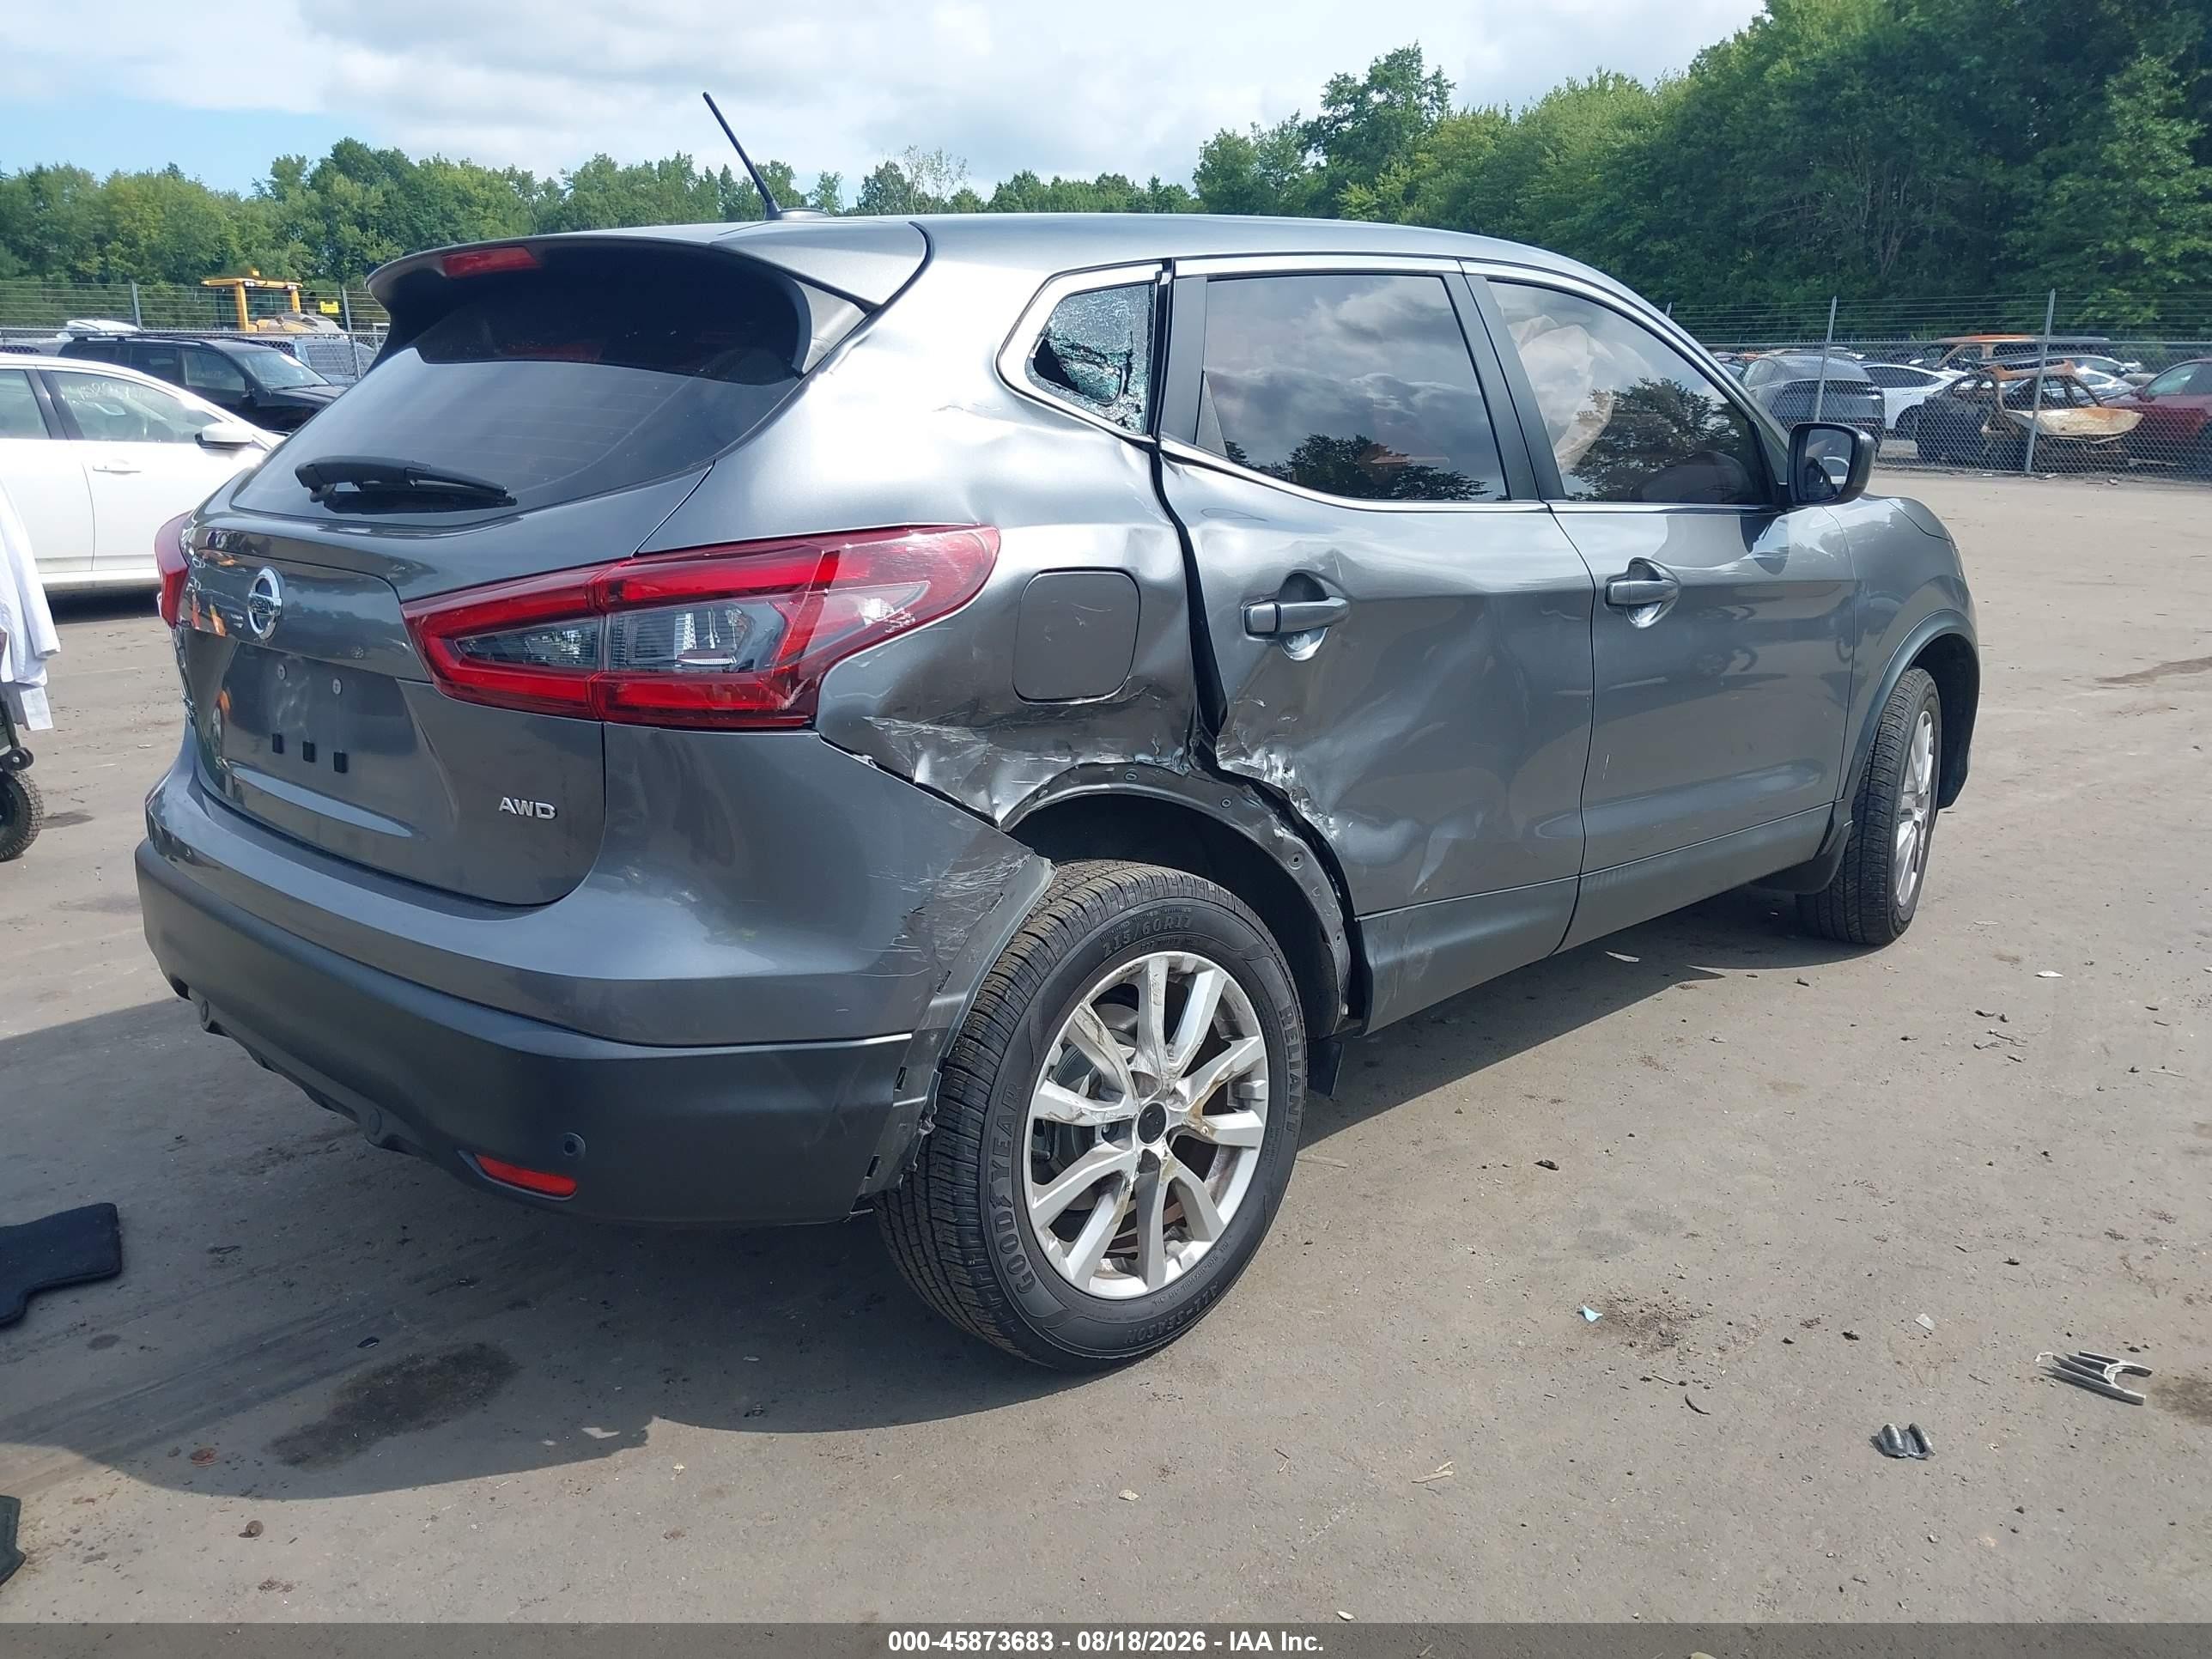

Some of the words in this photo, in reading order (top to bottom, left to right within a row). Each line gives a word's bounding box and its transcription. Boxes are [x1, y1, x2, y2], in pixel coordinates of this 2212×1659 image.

[499, 797, 556, 818] AWD
[1279, 1005, 1302, 1136] RELIANT
[989, 1084, 1036, 1294] GOODYEAR
